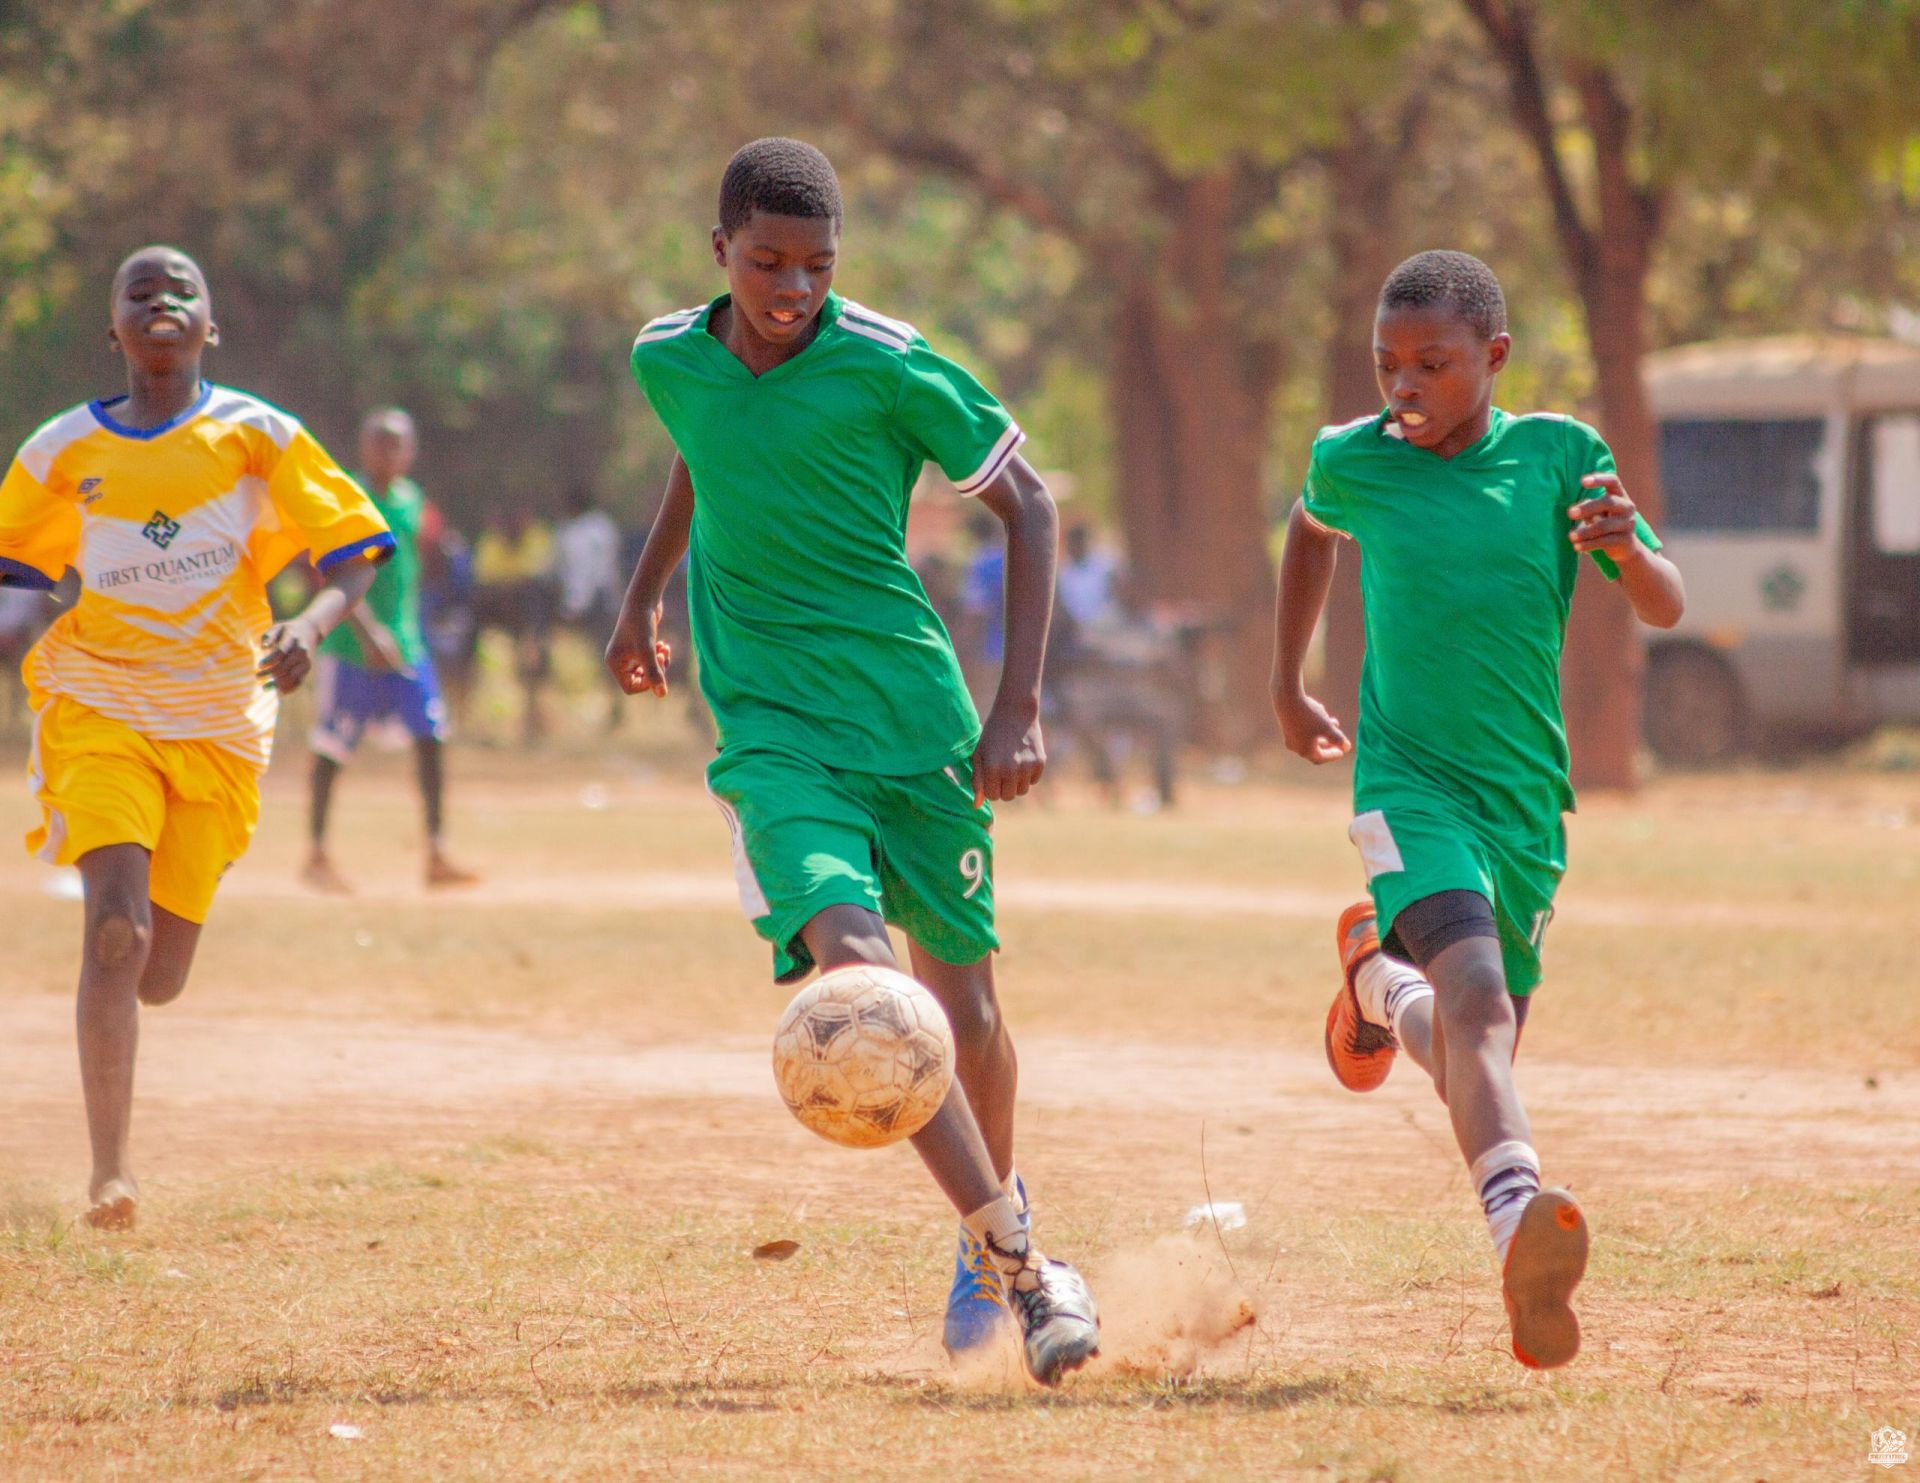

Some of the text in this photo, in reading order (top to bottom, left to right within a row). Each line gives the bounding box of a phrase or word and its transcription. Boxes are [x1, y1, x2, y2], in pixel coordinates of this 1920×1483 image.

[98, 566, 140, 589] FIRST
[145, 542, 236, 582] QUANTUM
[959, 848, 983, 900] 9
